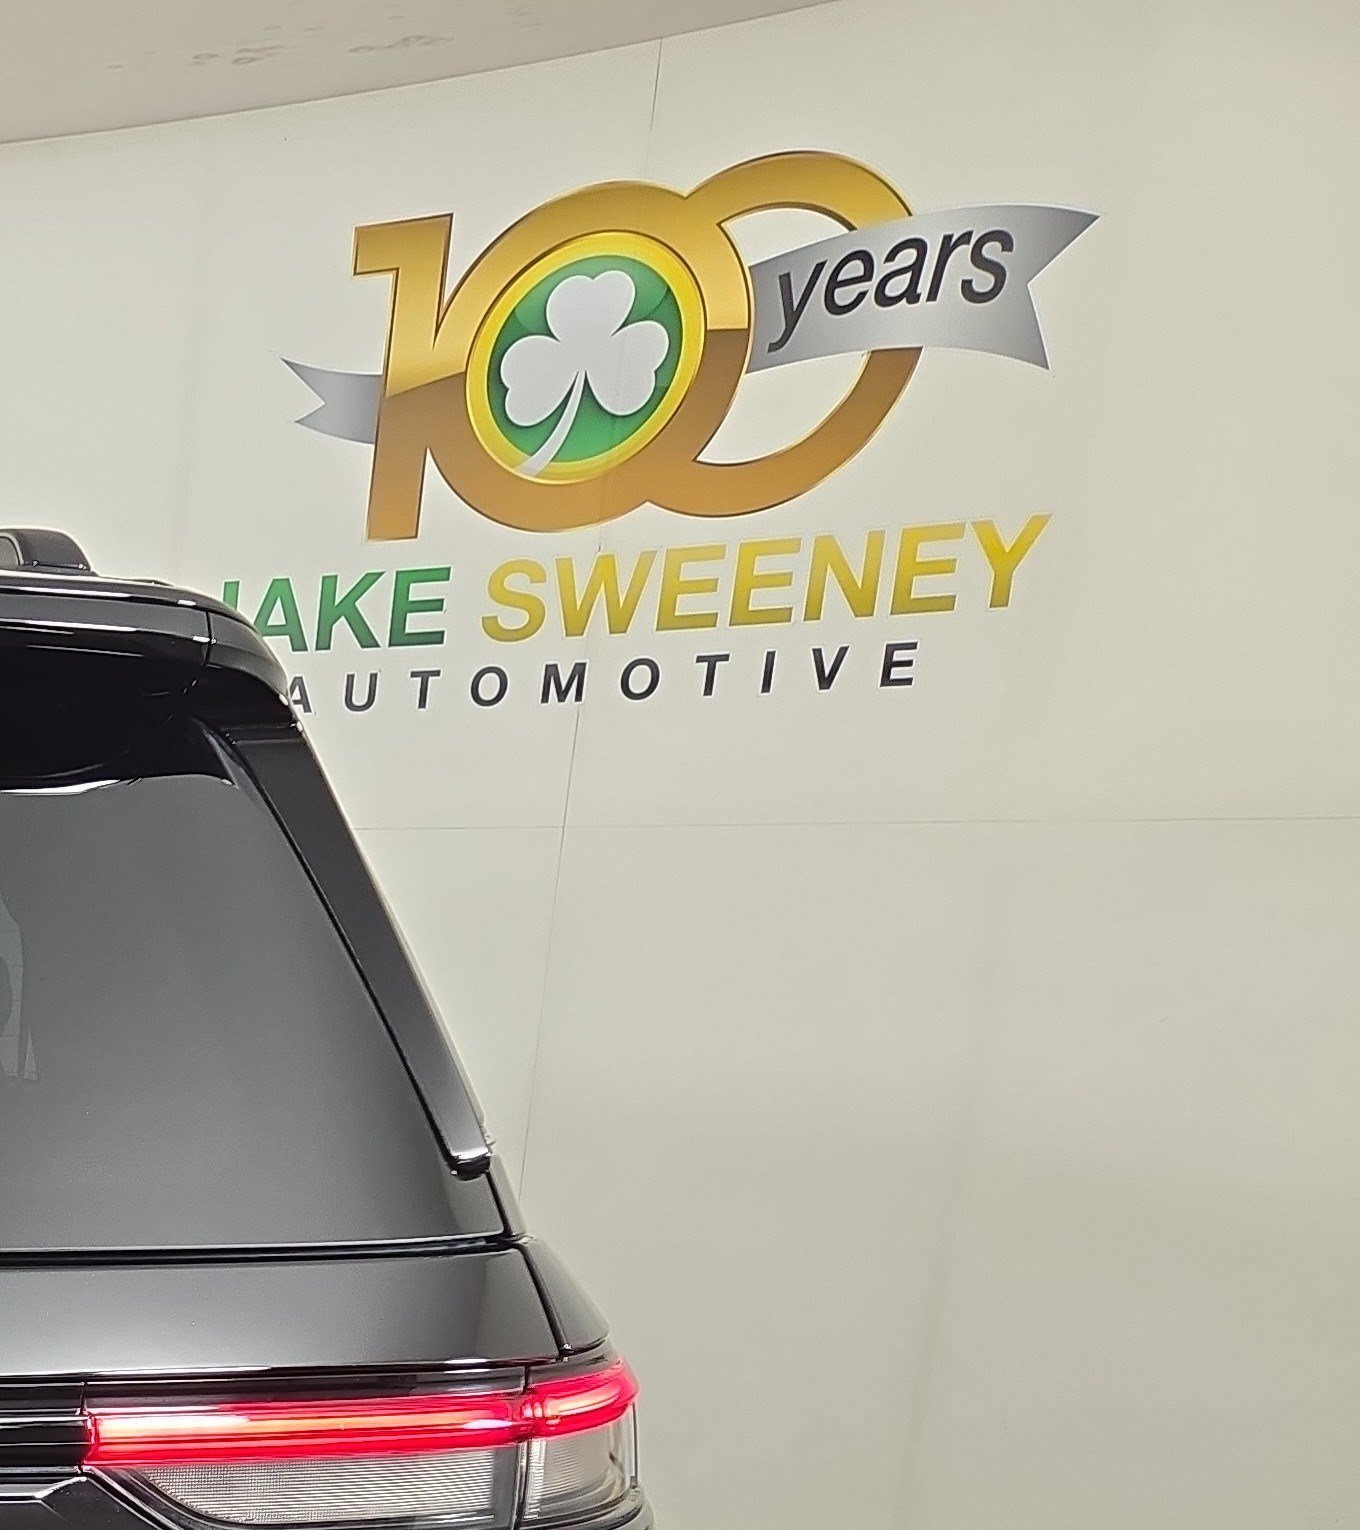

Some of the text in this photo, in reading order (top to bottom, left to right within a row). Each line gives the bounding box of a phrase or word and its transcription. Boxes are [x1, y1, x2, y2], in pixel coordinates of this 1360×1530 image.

[767, 229, 1013, 352] years
[480, 513, 1051, 643] SWEENEY
[290, 641, 918, 713] AUTOMOTIVE
